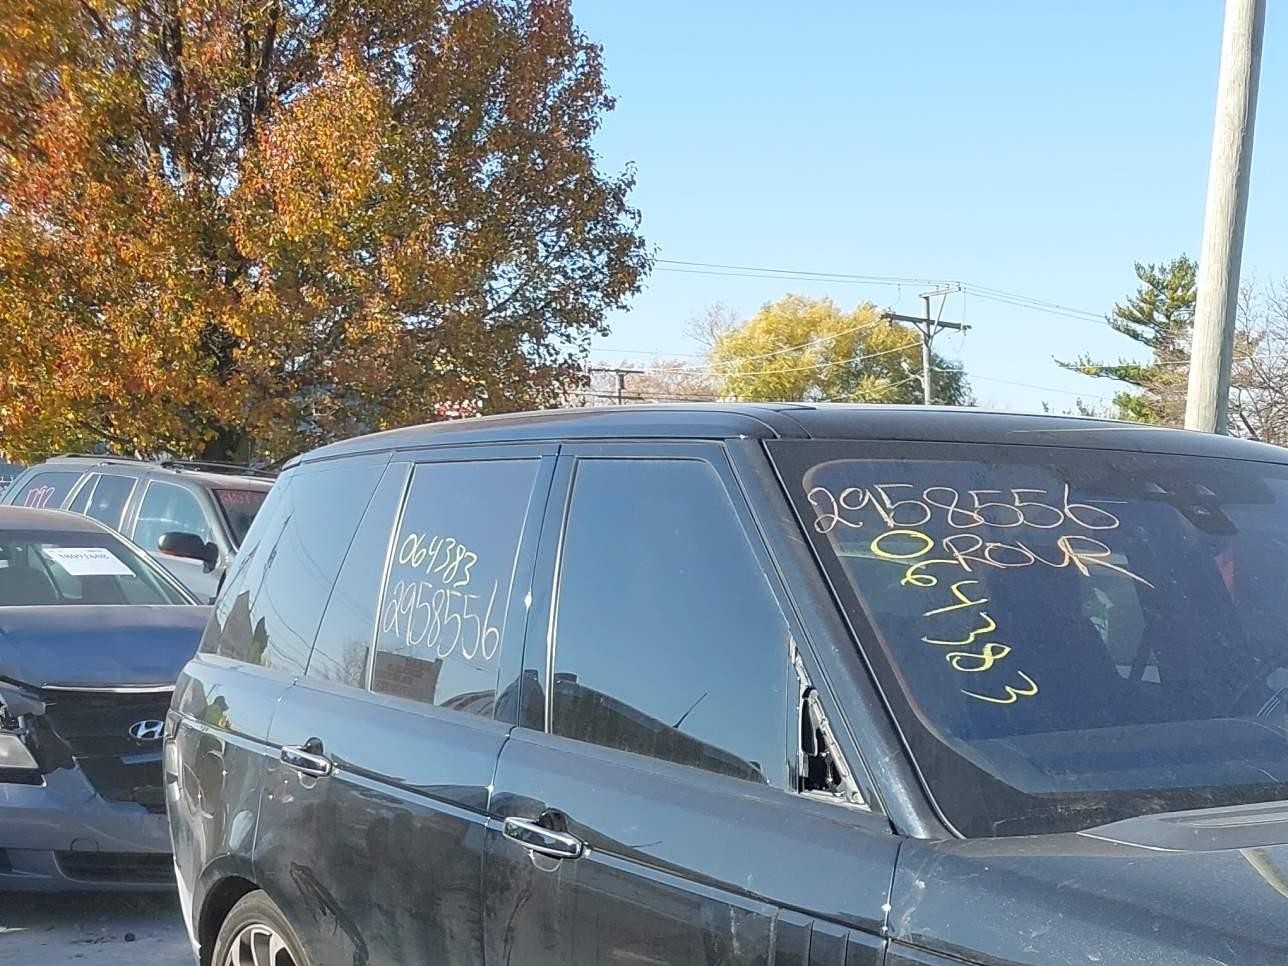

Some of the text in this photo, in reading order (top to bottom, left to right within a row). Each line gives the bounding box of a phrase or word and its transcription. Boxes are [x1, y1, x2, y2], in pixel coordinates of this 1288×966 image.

[807, 483, 1120, 533] 2958556
[399, 533, 478, 588] 064383
[383, 579, 500, 661] 2958556
